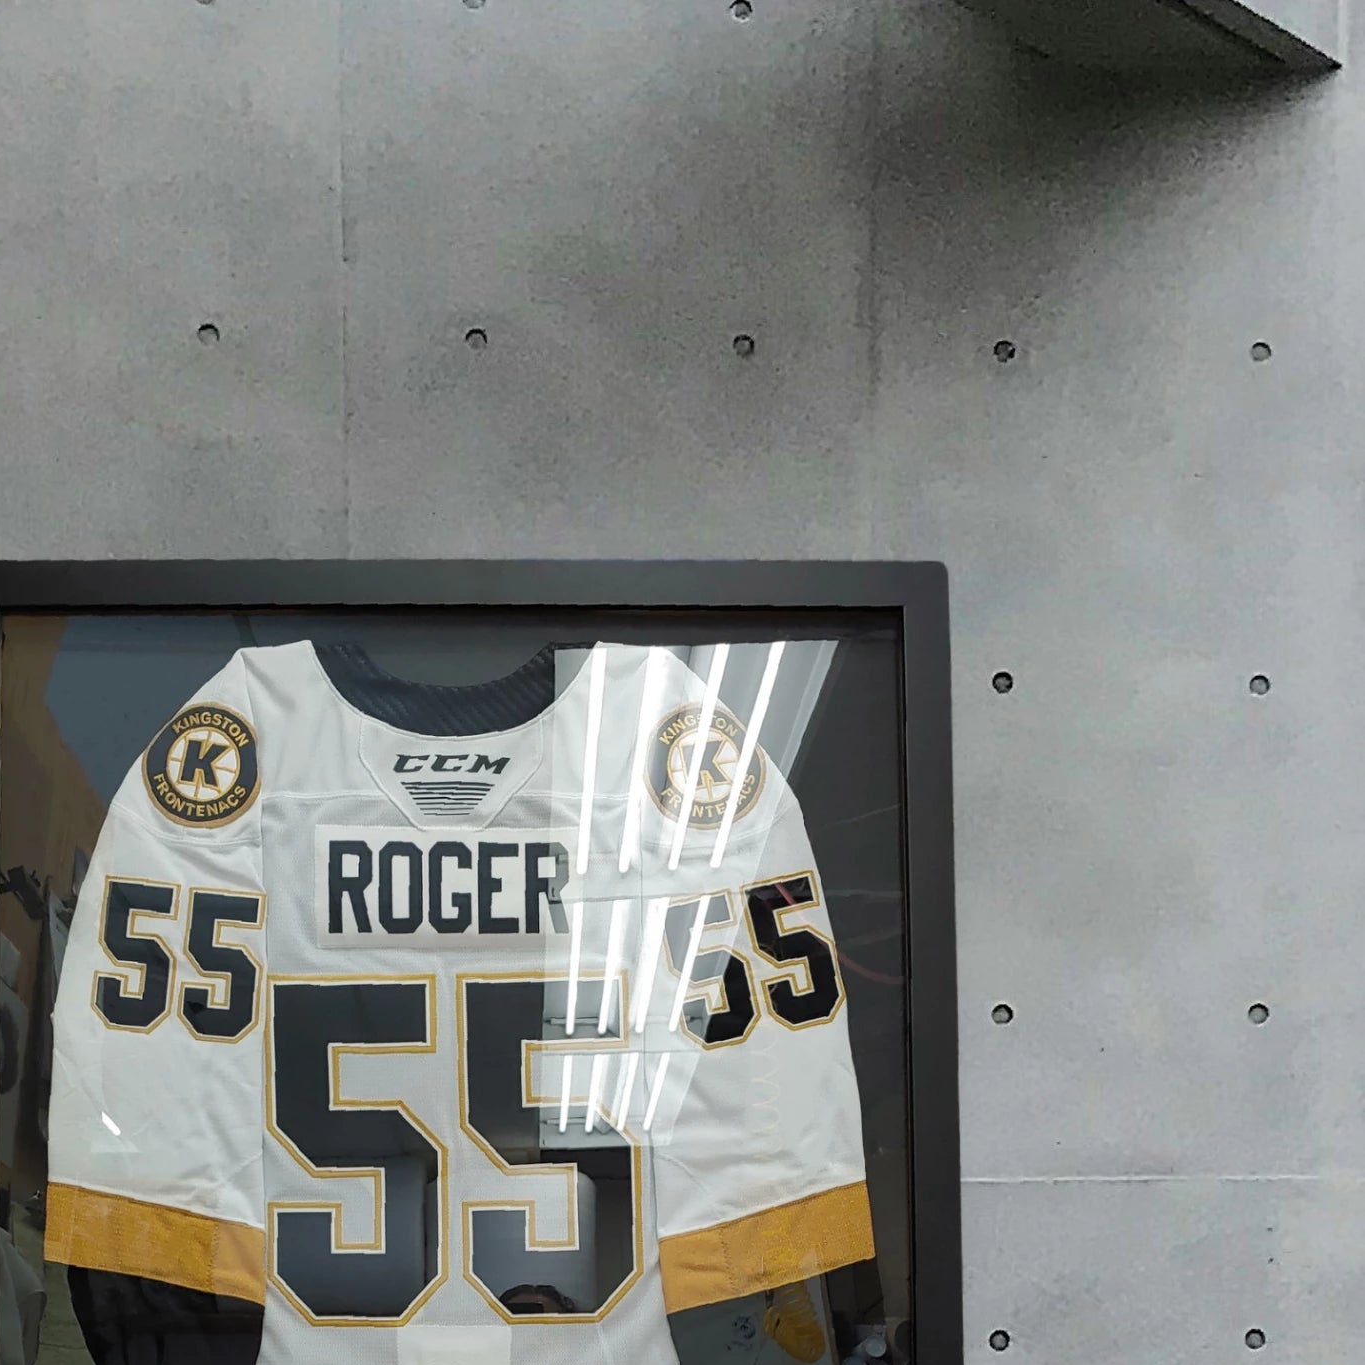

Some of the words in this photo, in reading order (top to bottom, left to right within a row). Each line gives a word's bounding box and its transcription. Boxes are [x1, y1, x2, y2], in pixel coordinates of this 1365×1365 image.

[172, 711, 250, 747] KINGSTON
[659, 713, 738, 745] KINGON
[177, 736, 235, 794] K
[392, 753, 511, 775] CCM
[153, 772, 247, 817] FRONTENACS
[660, 773, 755, 818] FRNTEACS
[328, 840, 570, 935] ROGER
[91, 874, 268, 1044] 55
[662, 870, 847, 1050] 55
[265, 972, 644, 1327] 55
